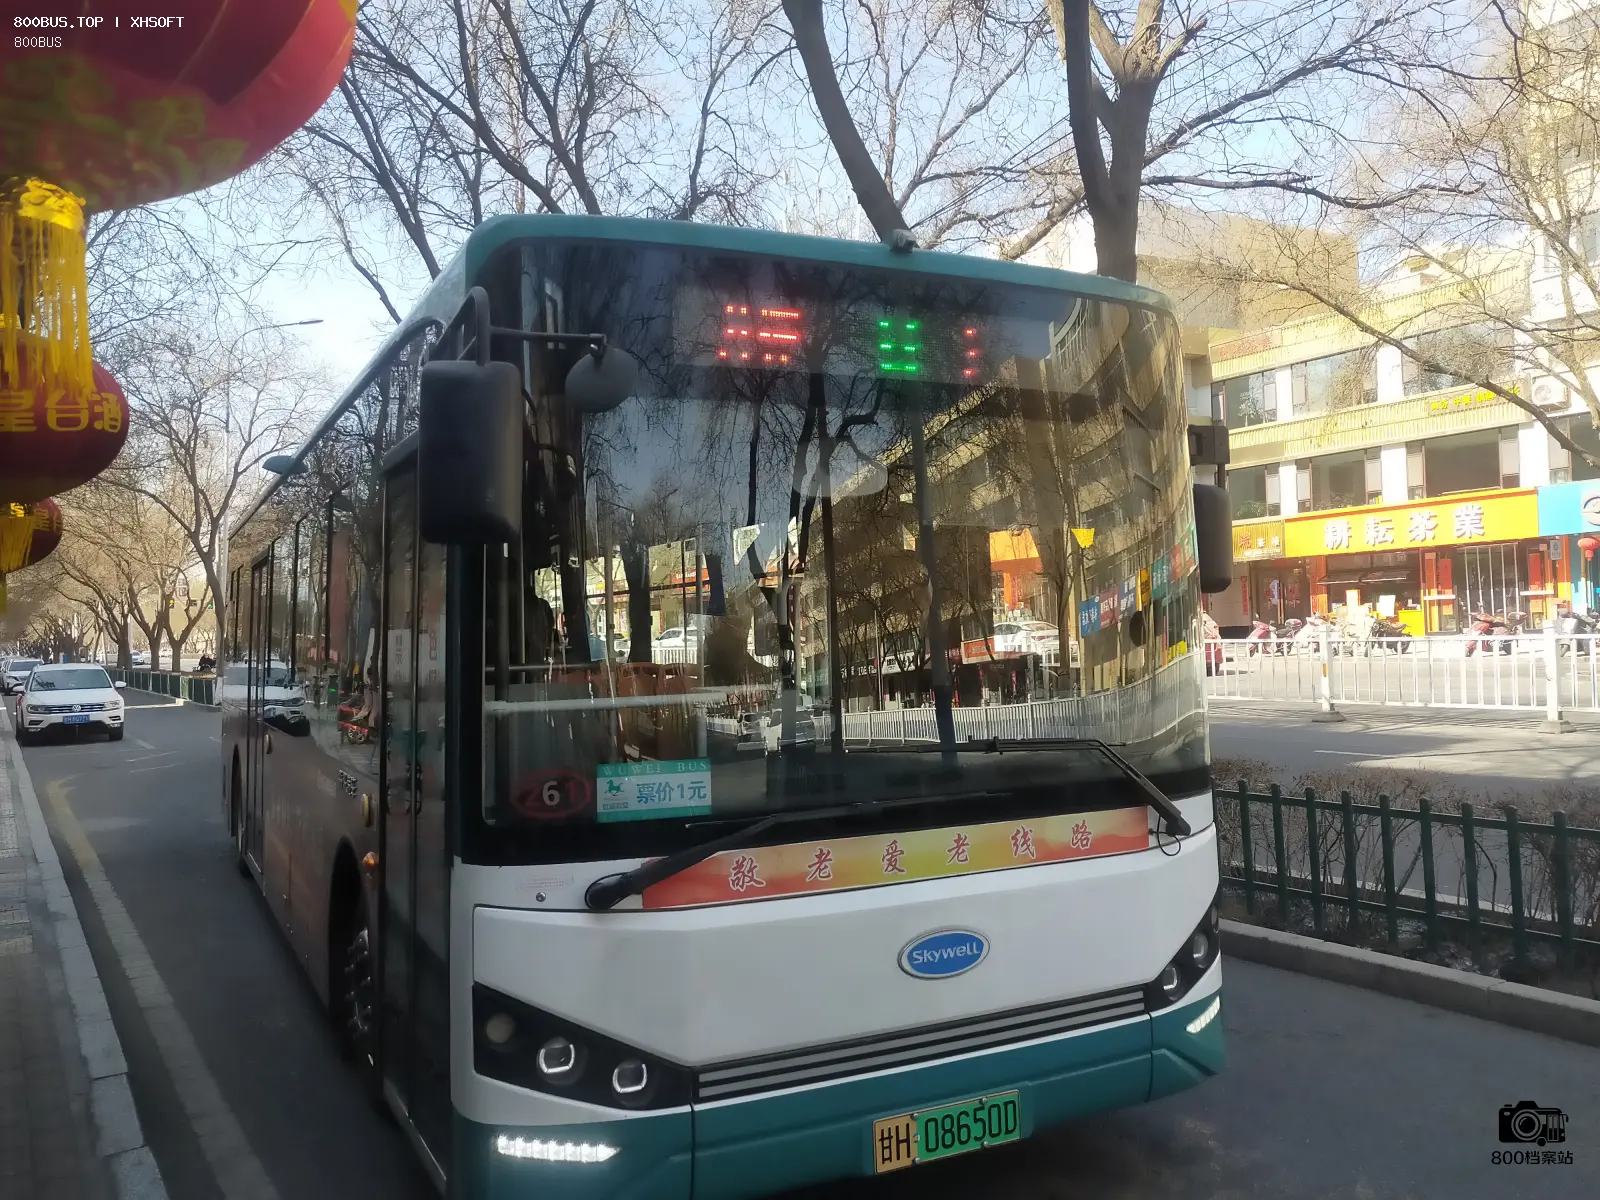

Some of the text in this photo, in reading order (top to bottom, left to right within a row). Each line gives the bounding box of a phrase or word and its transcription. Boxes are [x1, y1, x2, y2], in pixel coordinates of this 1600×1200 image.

[601, 761, 707, 776] WUWEI BUS
[542, 780, 561, 806] 6
[636, 780, 708, 804] 票价1元
[728, 819, 1094, 891] 敬老爱老线路
